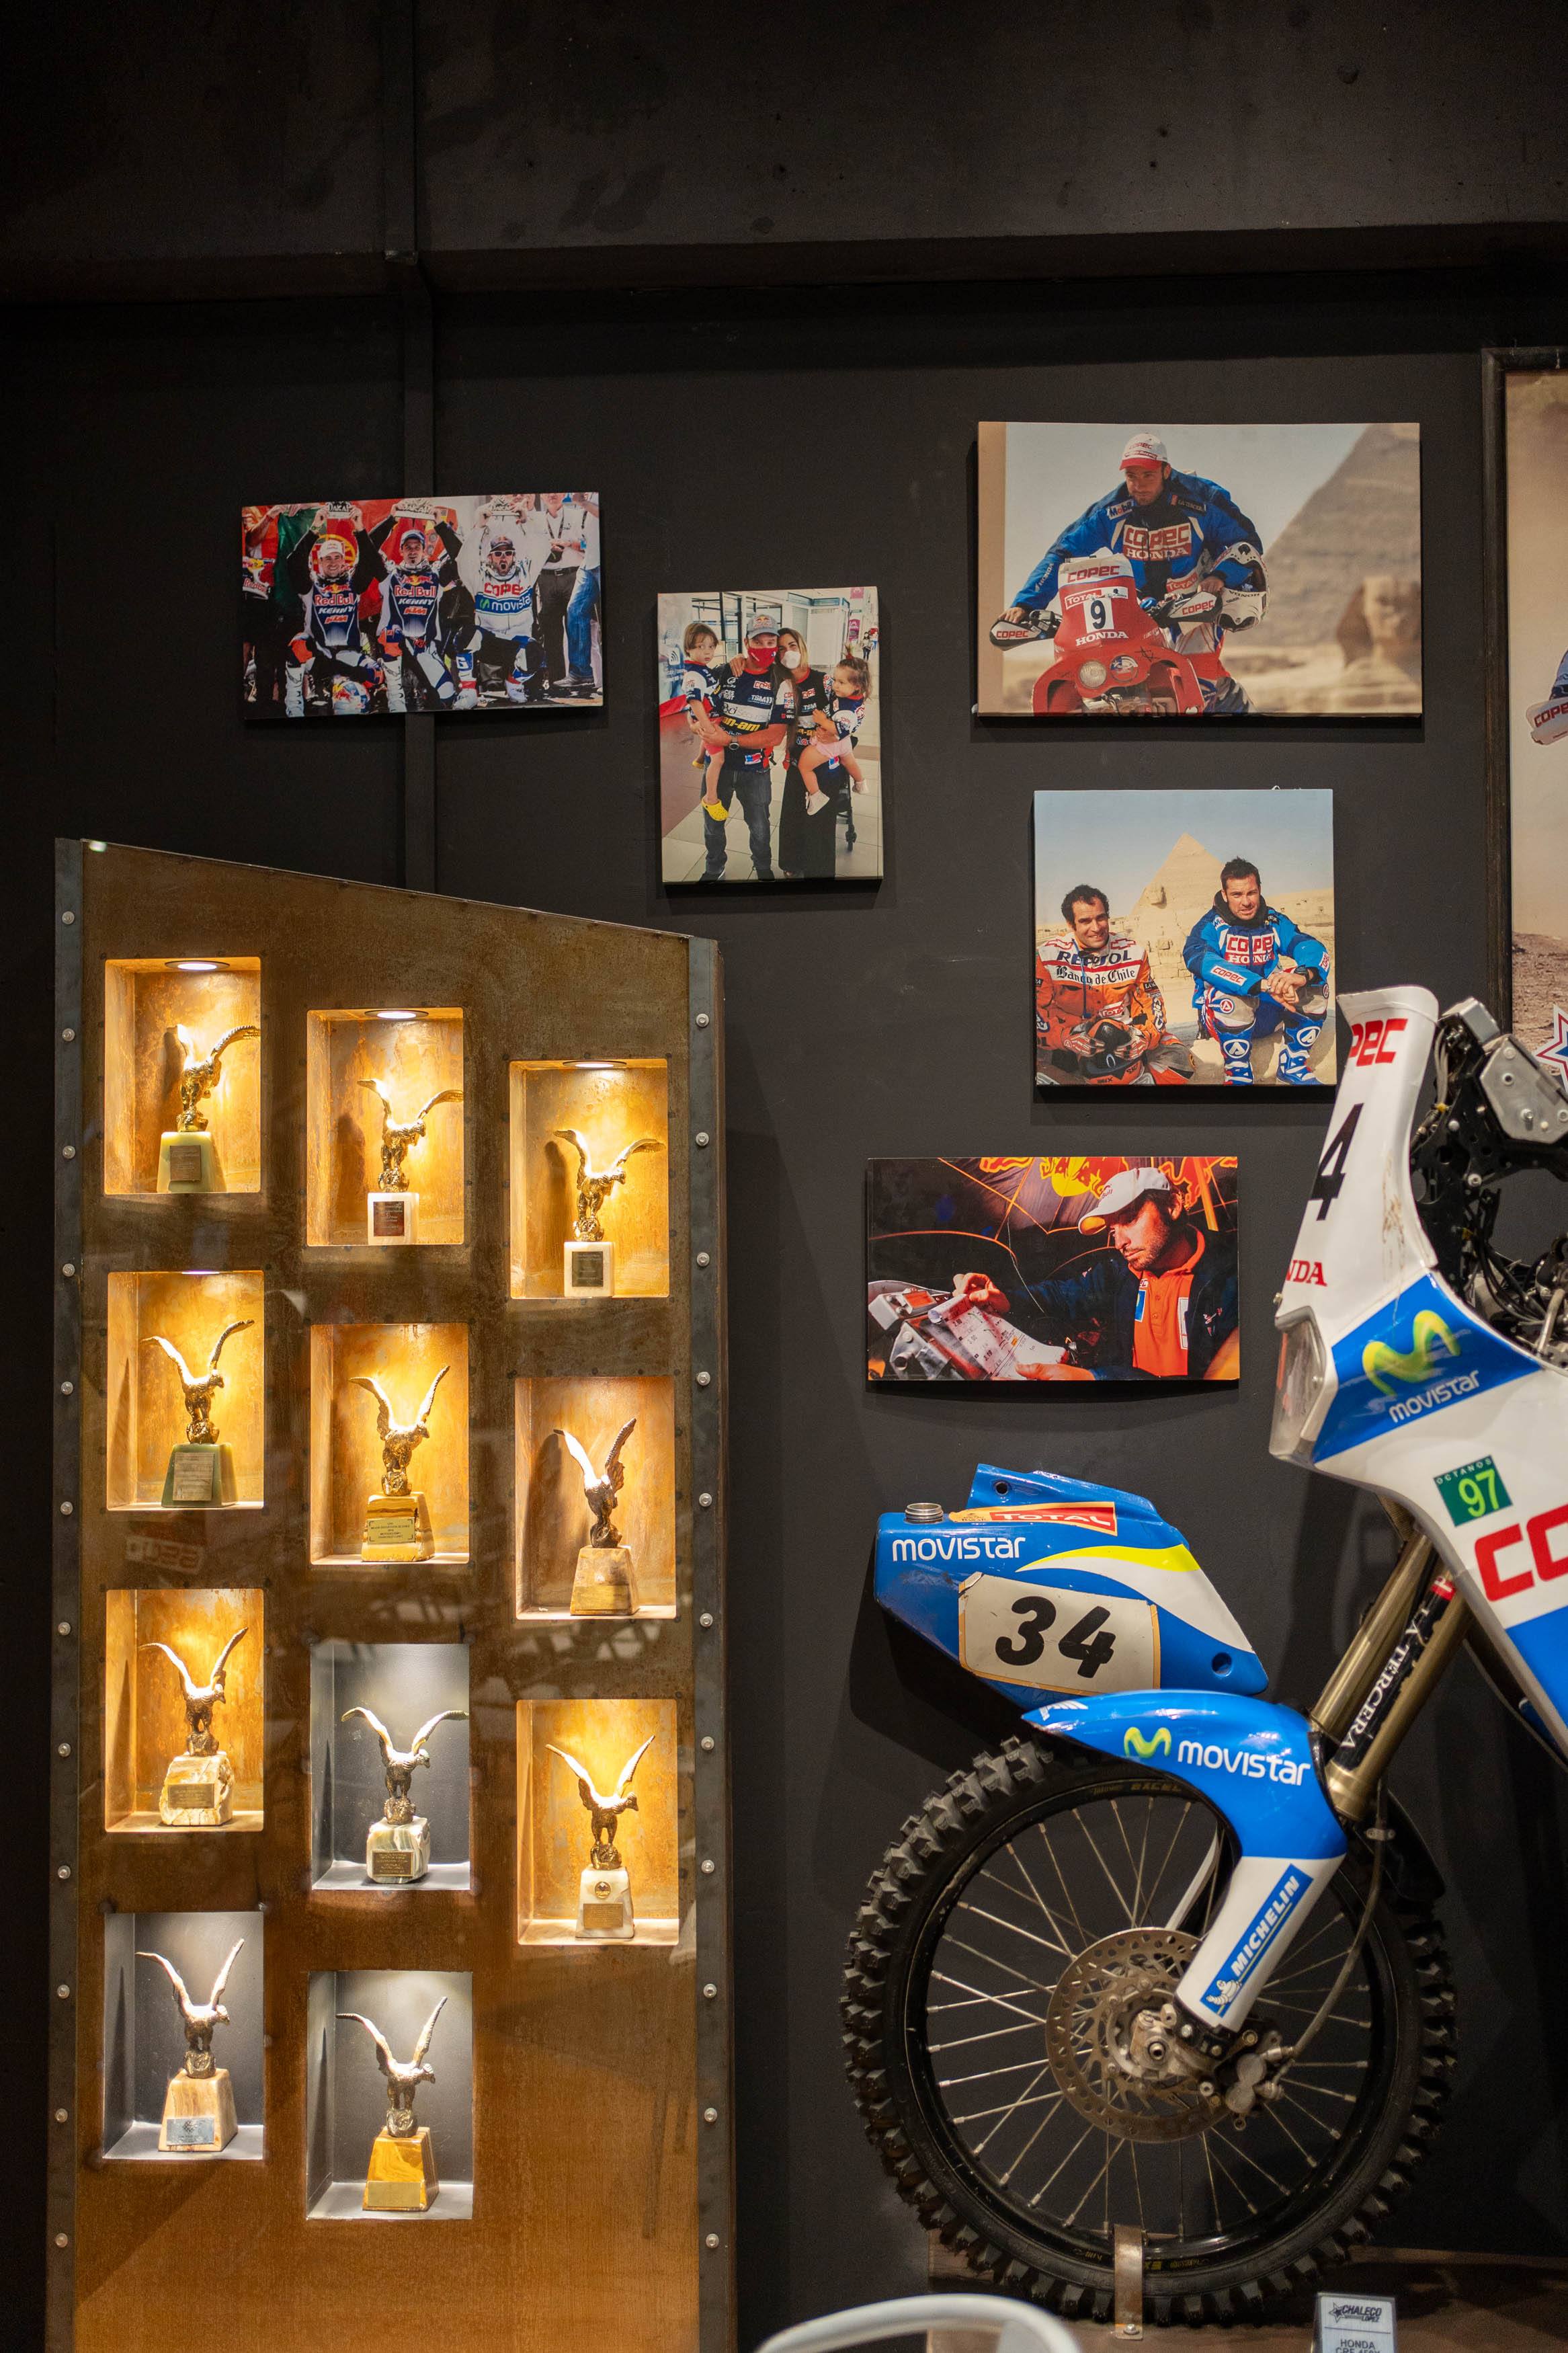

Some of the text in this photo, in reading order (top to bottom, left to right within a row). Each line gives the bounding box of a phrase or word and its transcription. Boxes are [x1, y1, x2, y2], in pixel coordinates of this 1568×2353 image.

[1125, 525, 1190, 549] COPEC
[1126, 547, 1189, 560] HONDA
[1067, 565, 1120, 584] COPEC
[314, 594, 335, 606] Red
[395, 585, 437, 597] Red Bull
[1090, 600, 1106, 630] 9
[1182, 600, 1215, 615] COPEC
[1075, 631, 1129, 647] HONDA
[1227, 935, 1274, 952] COPE
[1095, 973, 1106, 985] de
[1108, 968, 1135, 983] Chile
[1212, 967, 1245, 984] COPEC
[1309, 1103, 1364, 1222] 4
[1388, 1369, 1481, 1423] movistar
[1436, 1458, 1492, 1484] OCTANOS
[1458, 1468, 1499, 1517] 97
[994, 1513, 1111, 1527] TOTAL
[892, 1537, 1026, 1562] movistar
[995, 1595, 1117, 1679] 34
[1340, 1644, 1410, 1748] TERCERA
[1177, 1739, 1311, 1786] movistar
[1230, 1875, 1300, 1977] MICHELIN
[1340, 2339, 1376, 2350] HONDA
